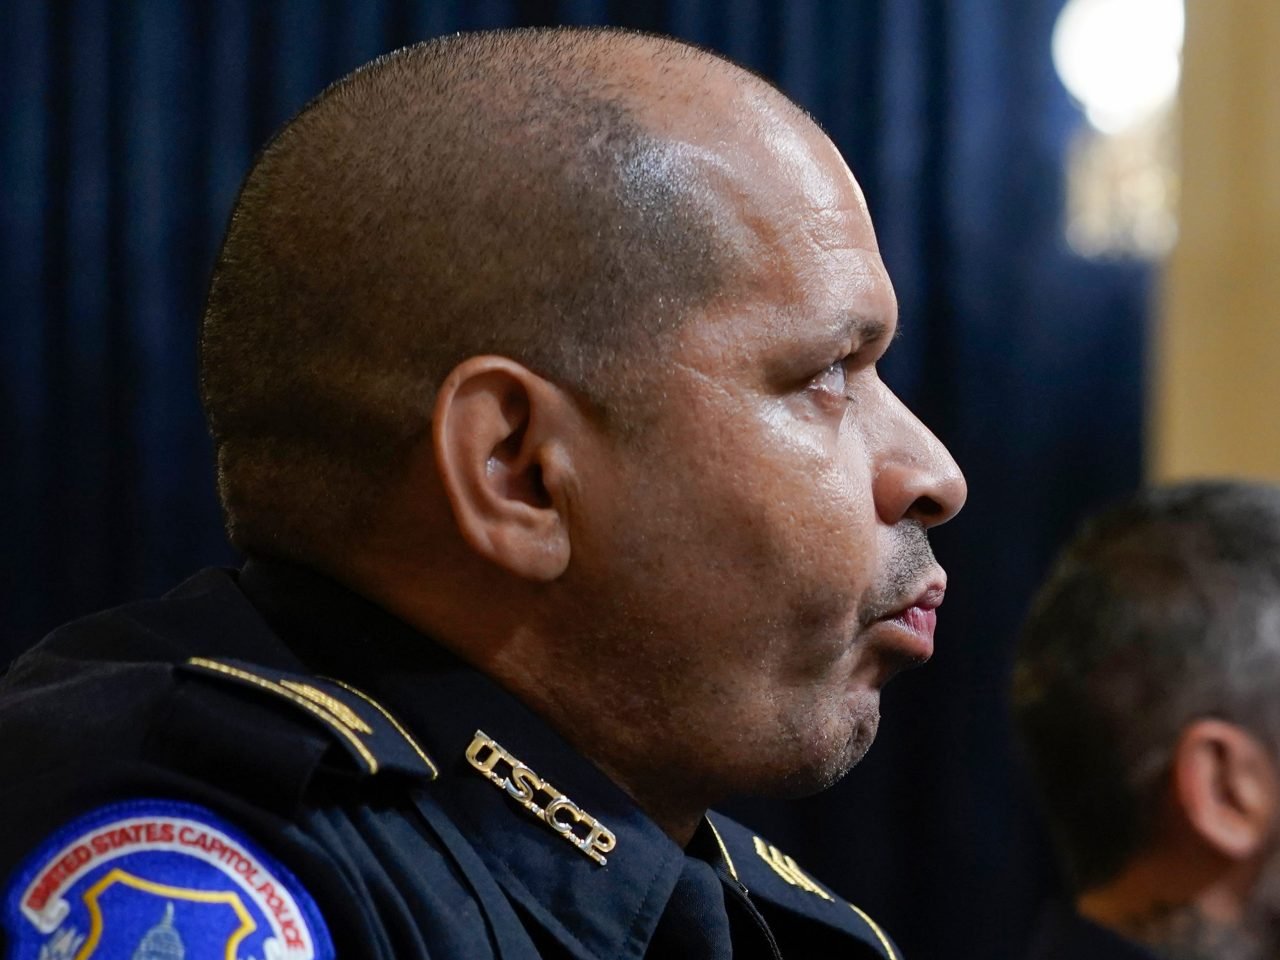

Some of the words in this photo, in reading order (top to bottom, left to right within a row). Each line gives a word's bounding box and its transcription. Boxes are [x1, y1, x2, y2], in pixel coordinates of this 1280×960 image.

[25, 844, 92, 912] UNITED
[91, 823, 175, 855] STATES
[178, 826, 258, 886] CAPITOL
[256, 881, 305, 951] POLICE
